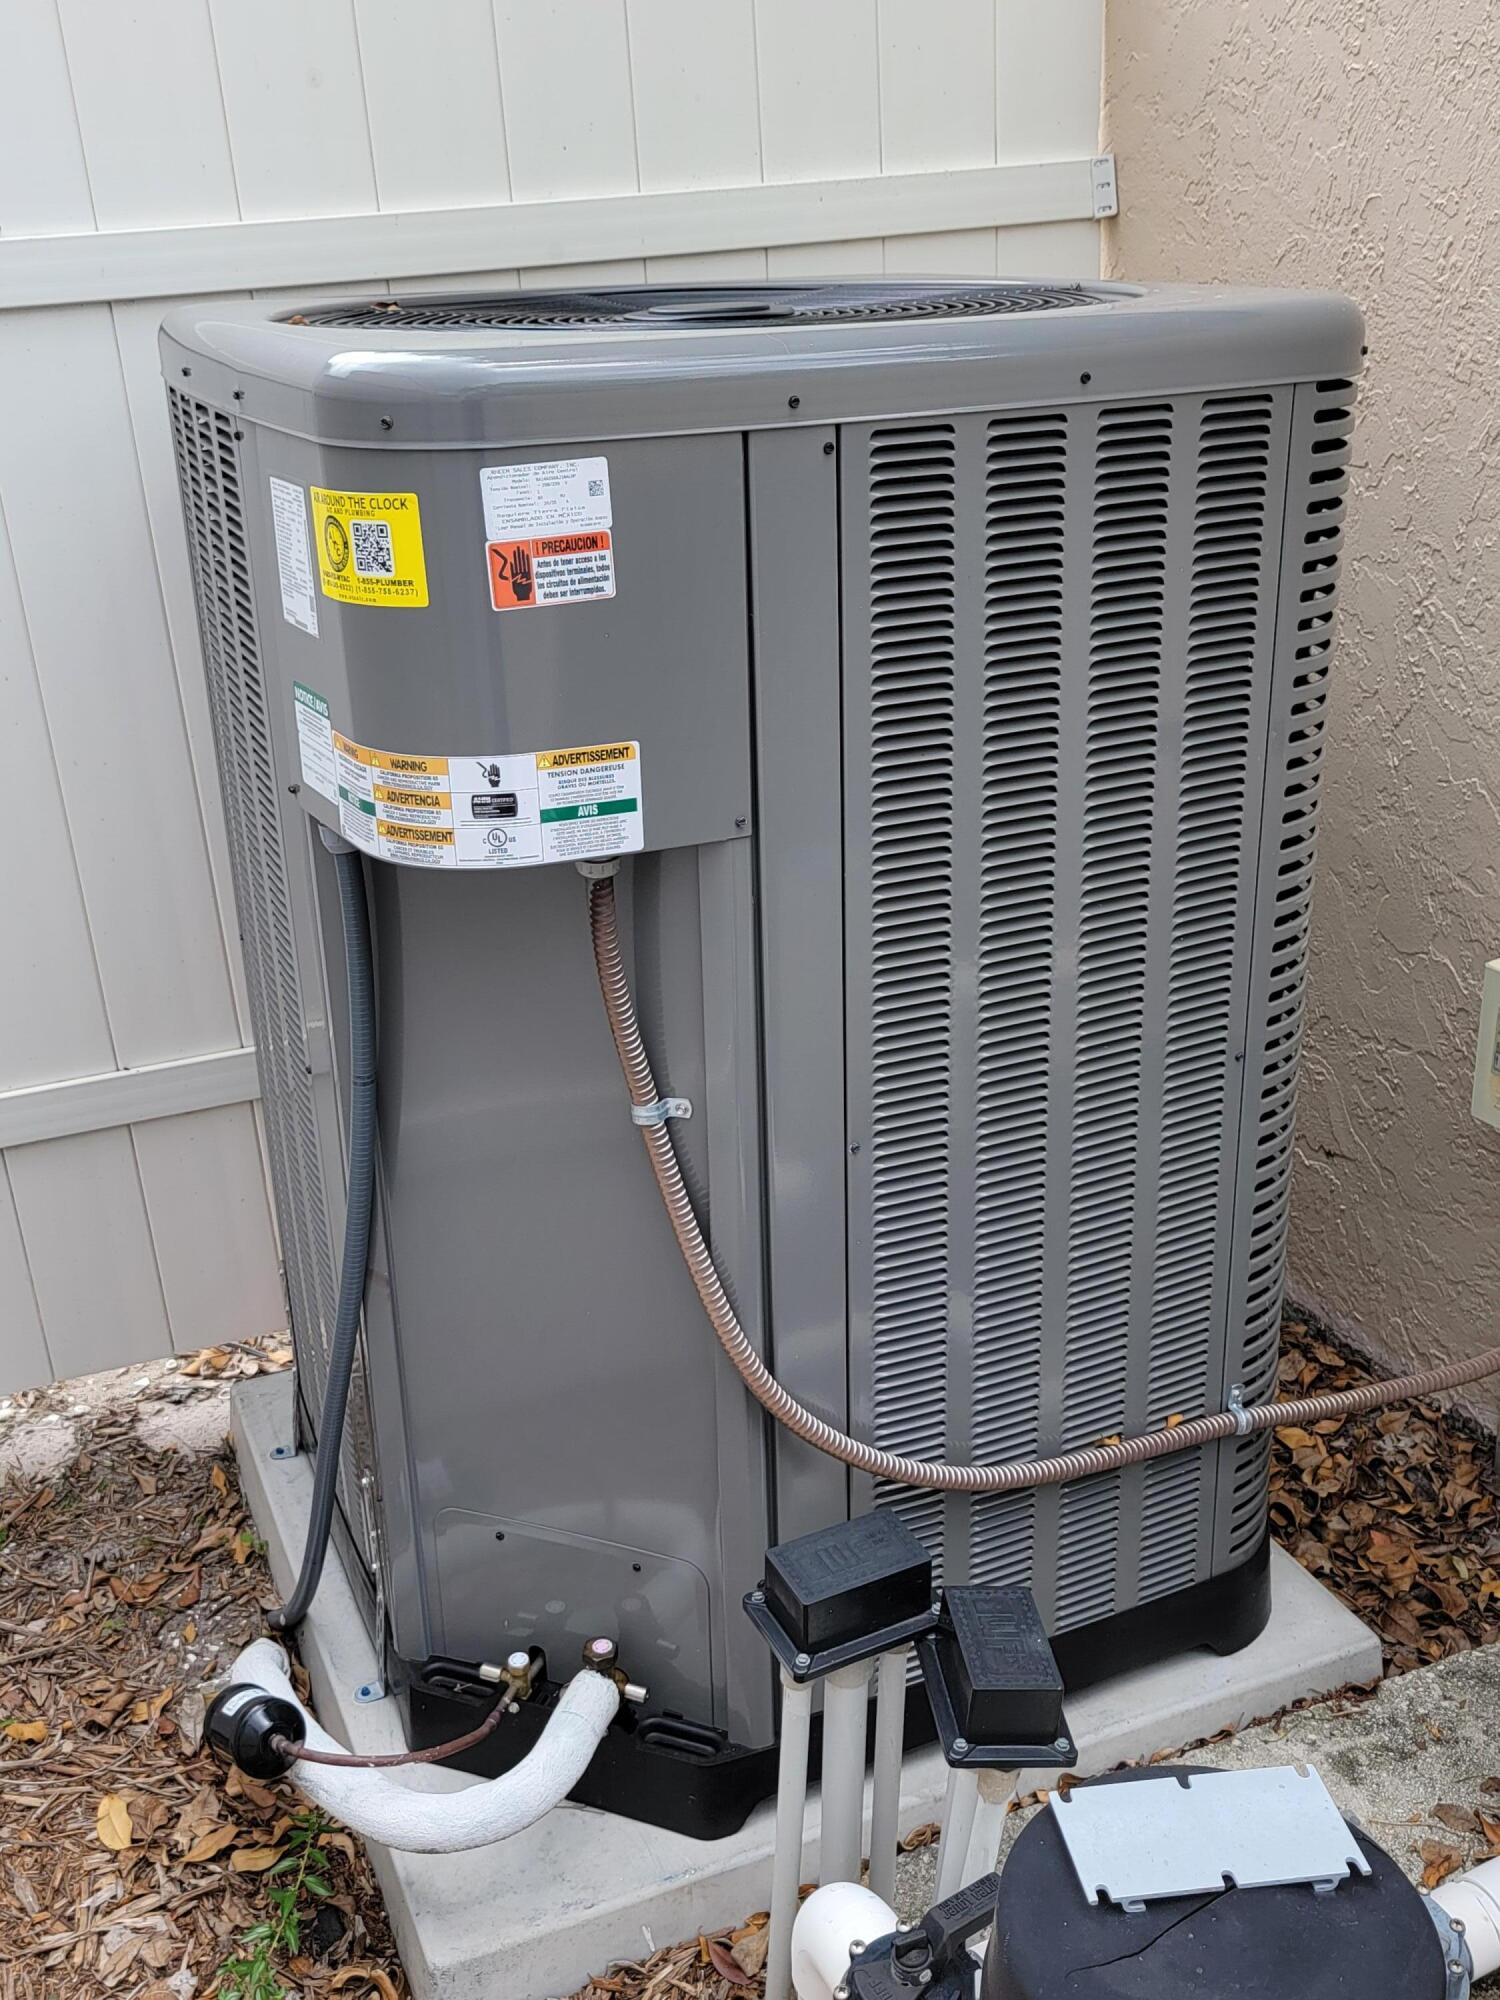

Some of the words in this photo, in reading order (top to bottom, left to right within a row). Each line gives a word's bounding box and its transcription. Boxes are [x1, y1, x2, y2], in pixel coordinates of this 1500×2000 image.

[348, 496, 366, 510] THE
[369, 498, 408, 510] CLOCK
[344, 508, 376, 517] PLUMBING
[542, 536, 598, 554] PRECAUCION
[536, 560, 552, 568] Antes
[560, 557, 574, 565] tener
[575, 556, 592, 564] acceso
[535, 569, 566, 580] dispositivos
[567, 566, 595, 576] terminales,
[596, 564, 610, 572] todos
[356, 577, 414, 587] 1-855-PLUMBER
[536, 582, 545, 590] los
[546, 579, 568, 588] circuitos
[570, 578, 576, 586] de
[578, 574, 610, 586] alimentación
[543, 590, 558, 600] deben
[570, 586, 607, 596] interrumpidos.
[552, 746, 630, 766] ADVERTISSEMENT
[390, 758, 428, 772] WARNING
[548, 768, 578, 778] TENSION
[580, 764, 624, 774] DANGEREUSE
[387, 790, 440, 807] ADVERTENCIA
[578, 804, 598, 817] AVIS
[386, 825, 453, 842] ADVERTISSEMENT
[492, 832, 502, 844] UL
